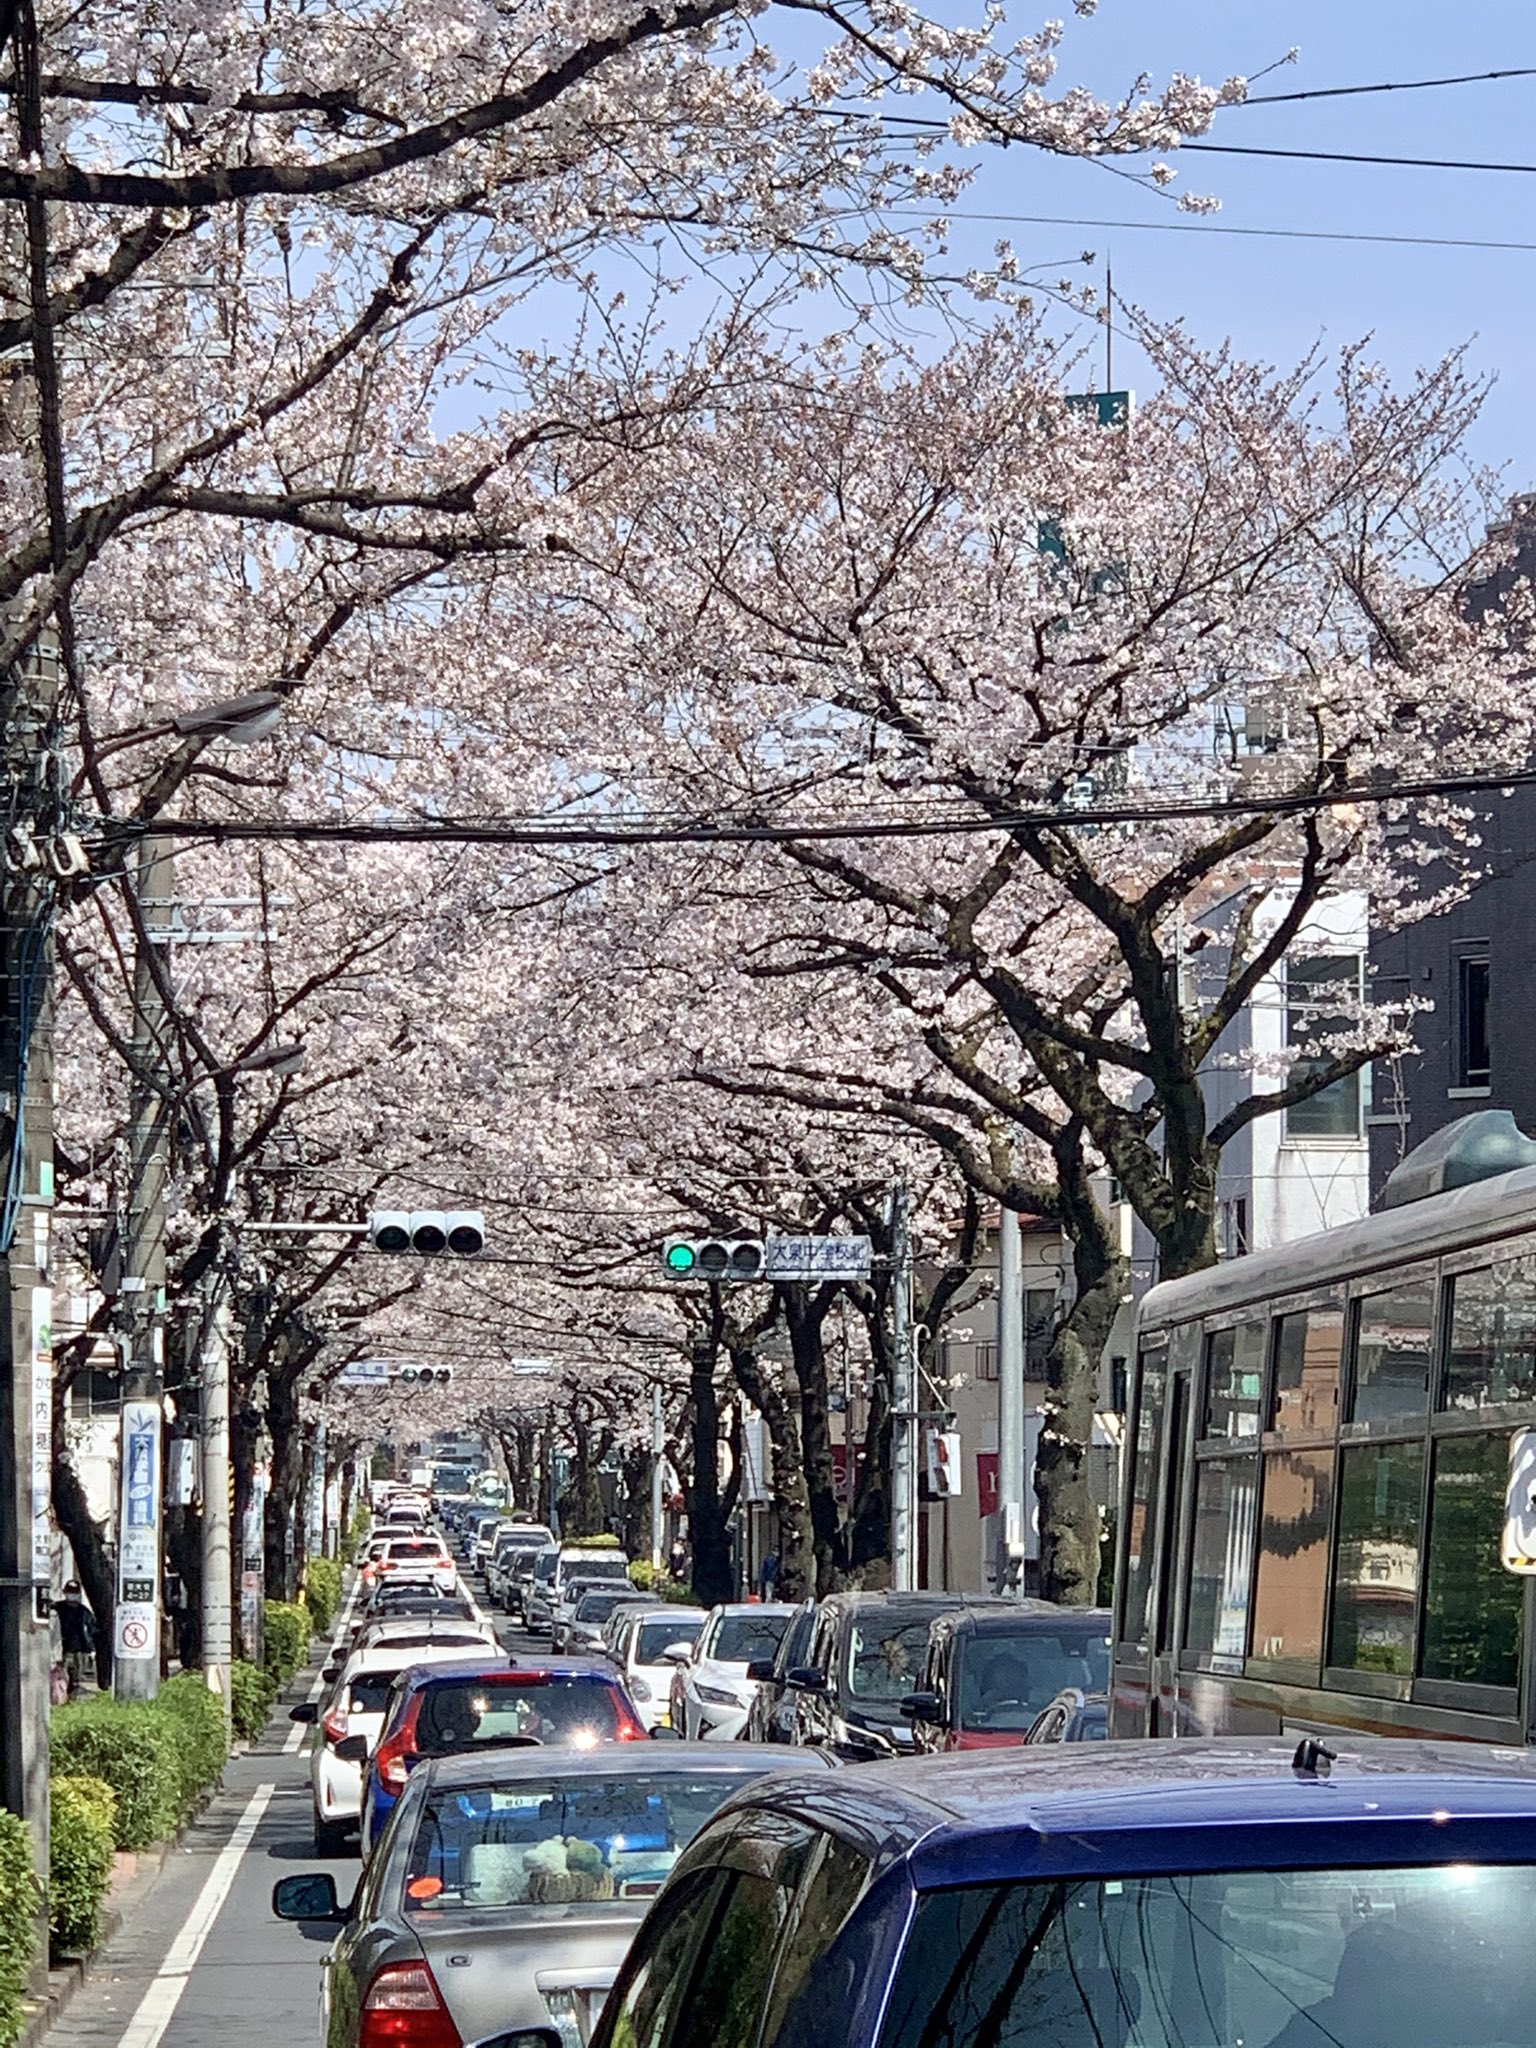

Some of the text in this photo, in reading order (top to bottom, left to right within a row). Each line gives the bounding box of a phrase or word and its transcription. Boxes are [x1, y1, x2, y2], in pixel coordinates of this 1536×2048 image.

[772, 1241, 866, 1261] 大泉中学校北
